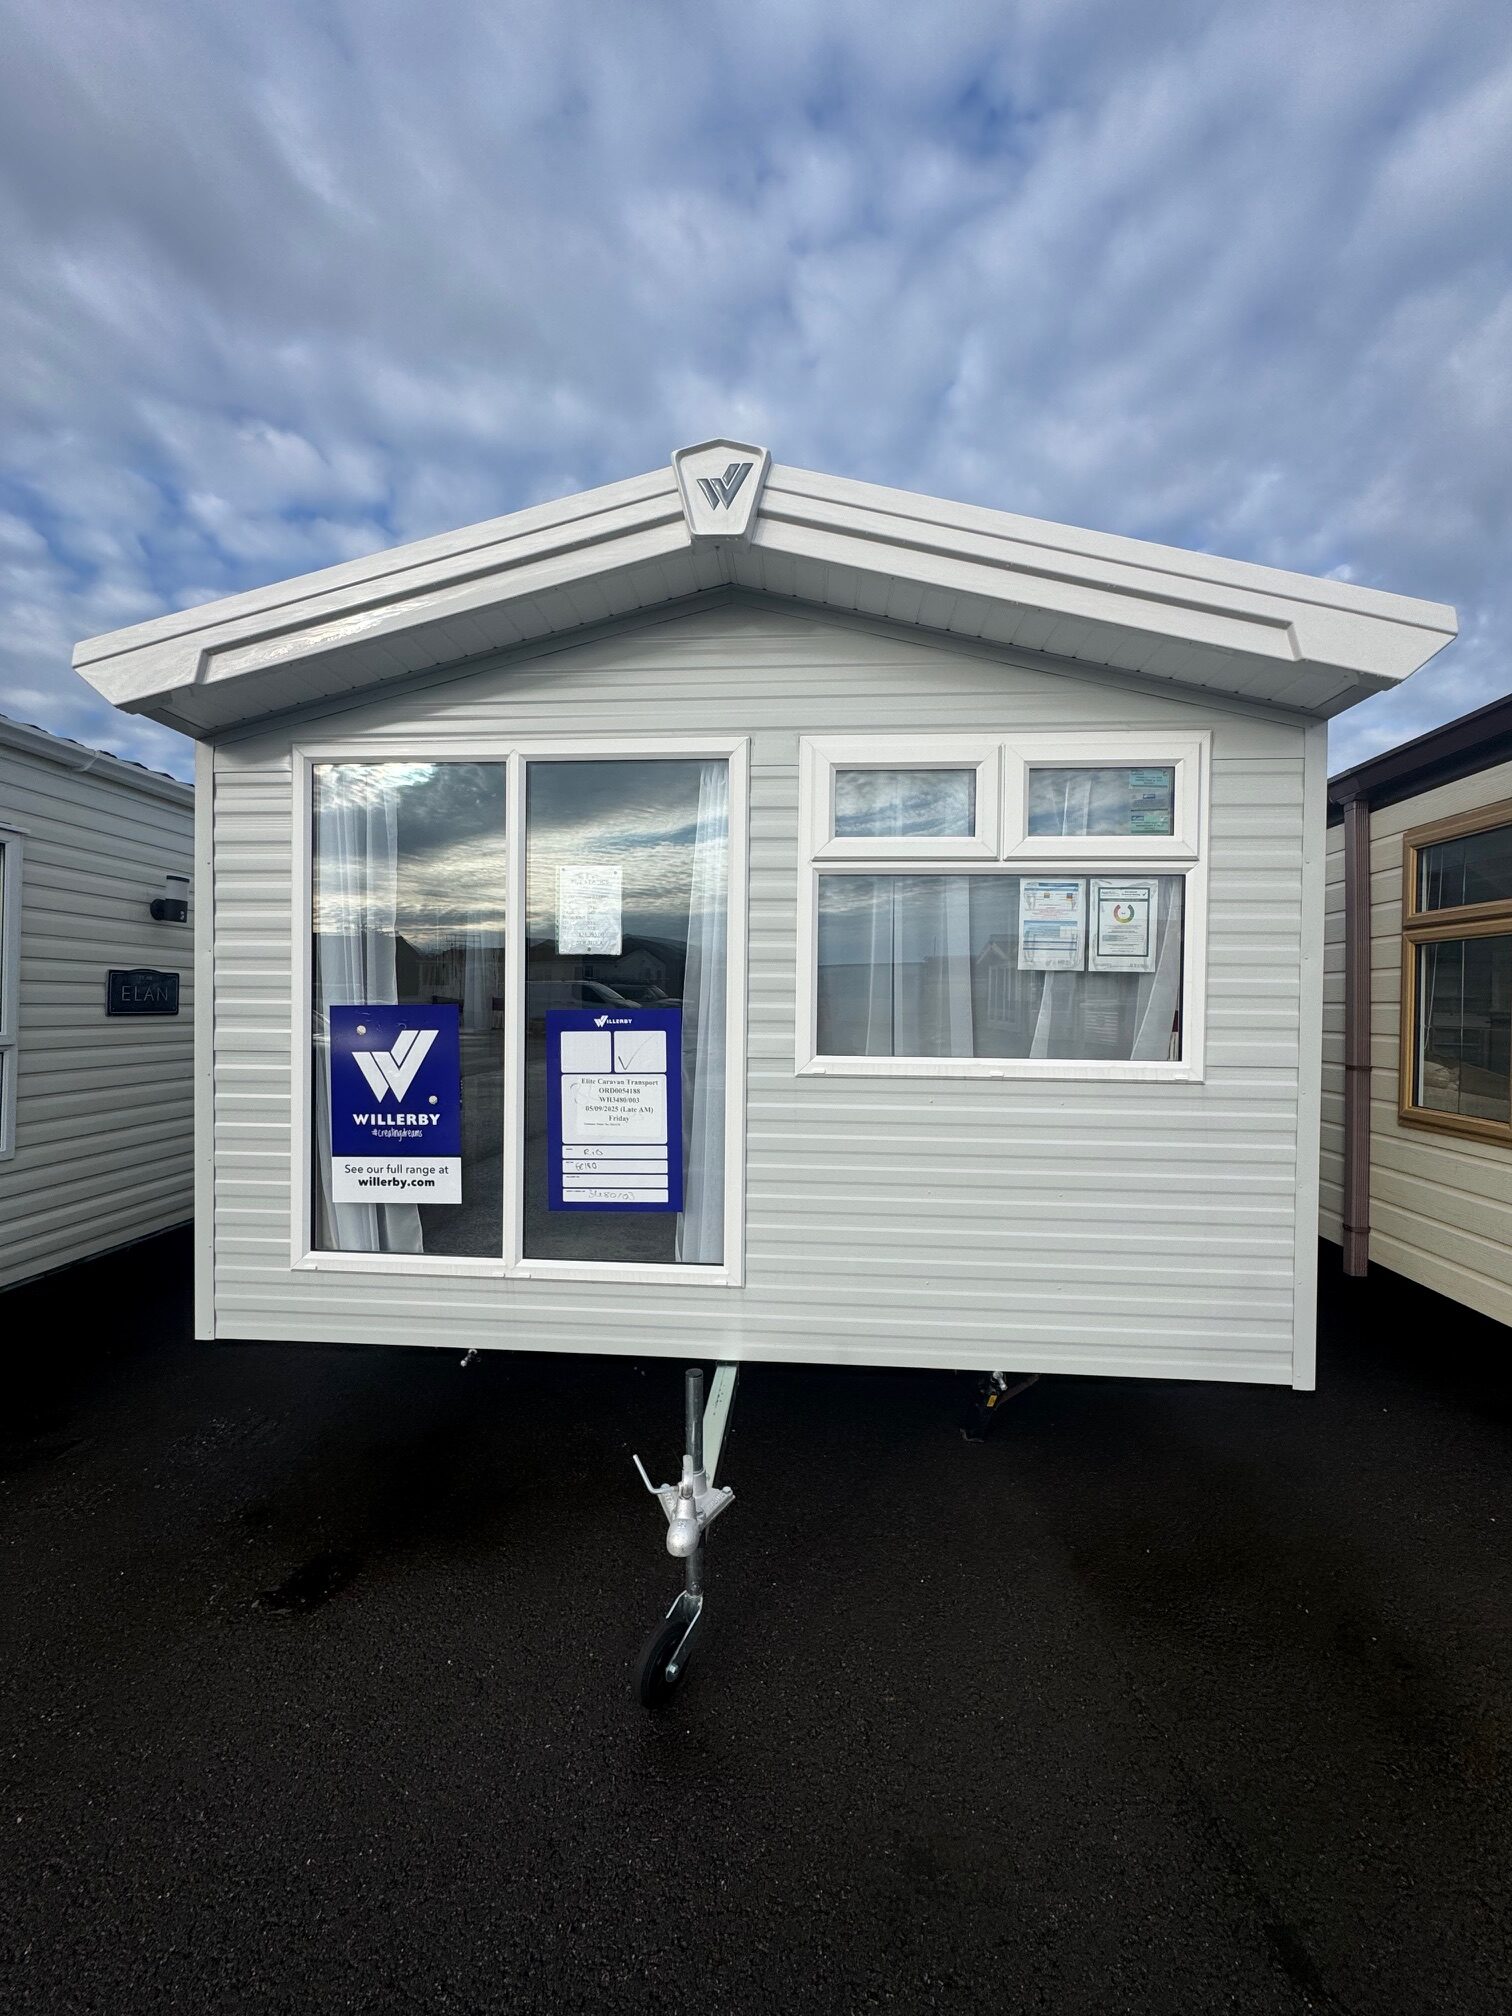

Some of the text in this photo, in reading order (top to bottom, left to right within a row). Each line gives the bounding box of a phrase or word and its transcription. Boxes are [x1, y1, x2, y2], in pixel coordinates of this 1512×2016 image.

[121, 985, 168, 1002] ELAN
[581, 1077, 659, 1087] Elite Caravan Transport
[638, 1106, 654, 1114] AM)
[352, 1113, 440, 1126] WILLERBY
[608, 1115, 629, 1123] Friday
[371, 1127, 423, 1142] #creatingdreams
[344, 1163, 449, 1177] See our full range at
[358, 1177, 435, 1189] willerby.com
